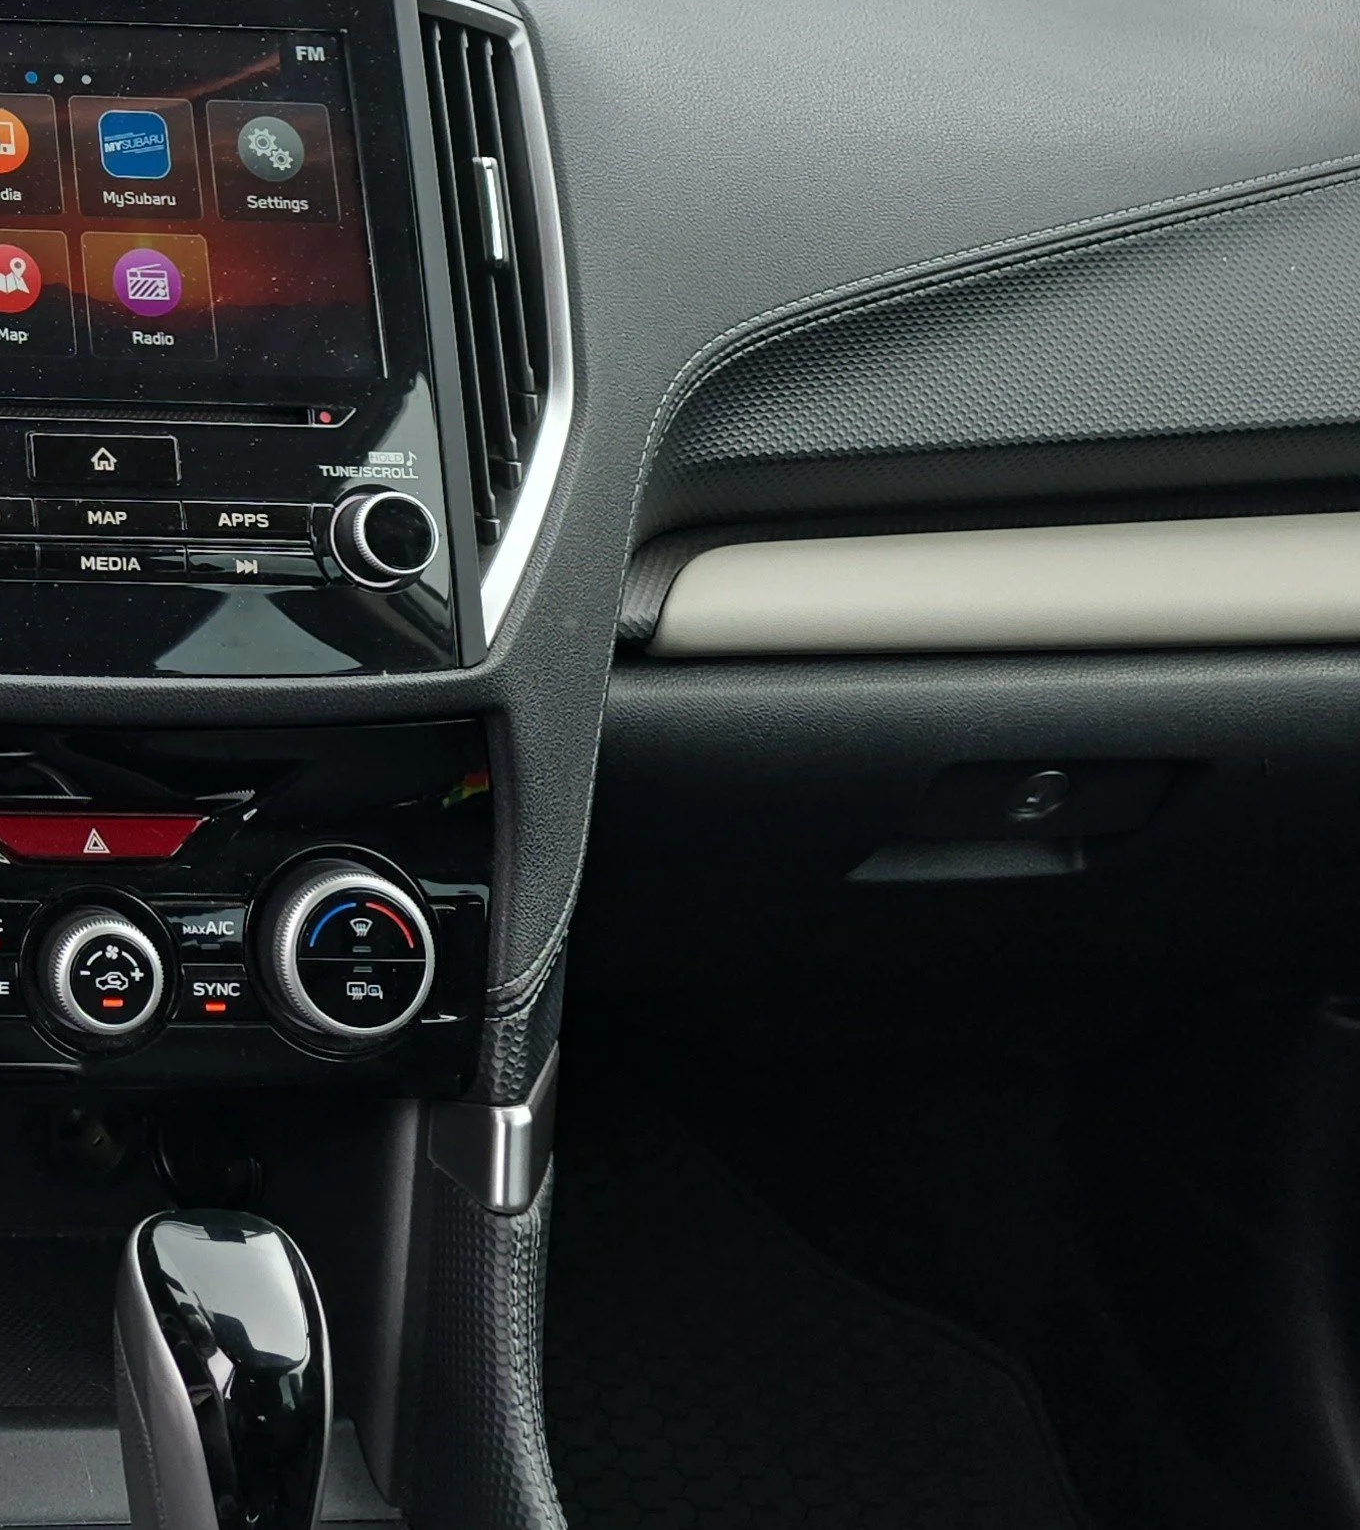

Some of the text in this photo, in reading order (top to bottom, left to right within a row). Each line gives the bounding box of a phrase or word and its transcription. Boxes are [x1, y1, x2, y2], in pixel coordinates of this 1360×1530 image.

[295, 45, 326, 62] FM
[103, 191, 176, 207] MySubaru
[246, 194, 309, 212] Settings
[132, 329, 175, 347] Radio
[370, 452, 403, 463] HOLD
[319, 464, 419, 480] TUNE/SCROLL
[87, 508, 128, 527] MAP
[218, 511, 270, 530] APPS
[80, 554, 141, 573] MEDIA
[193, 982, 241, 997] SYNC
